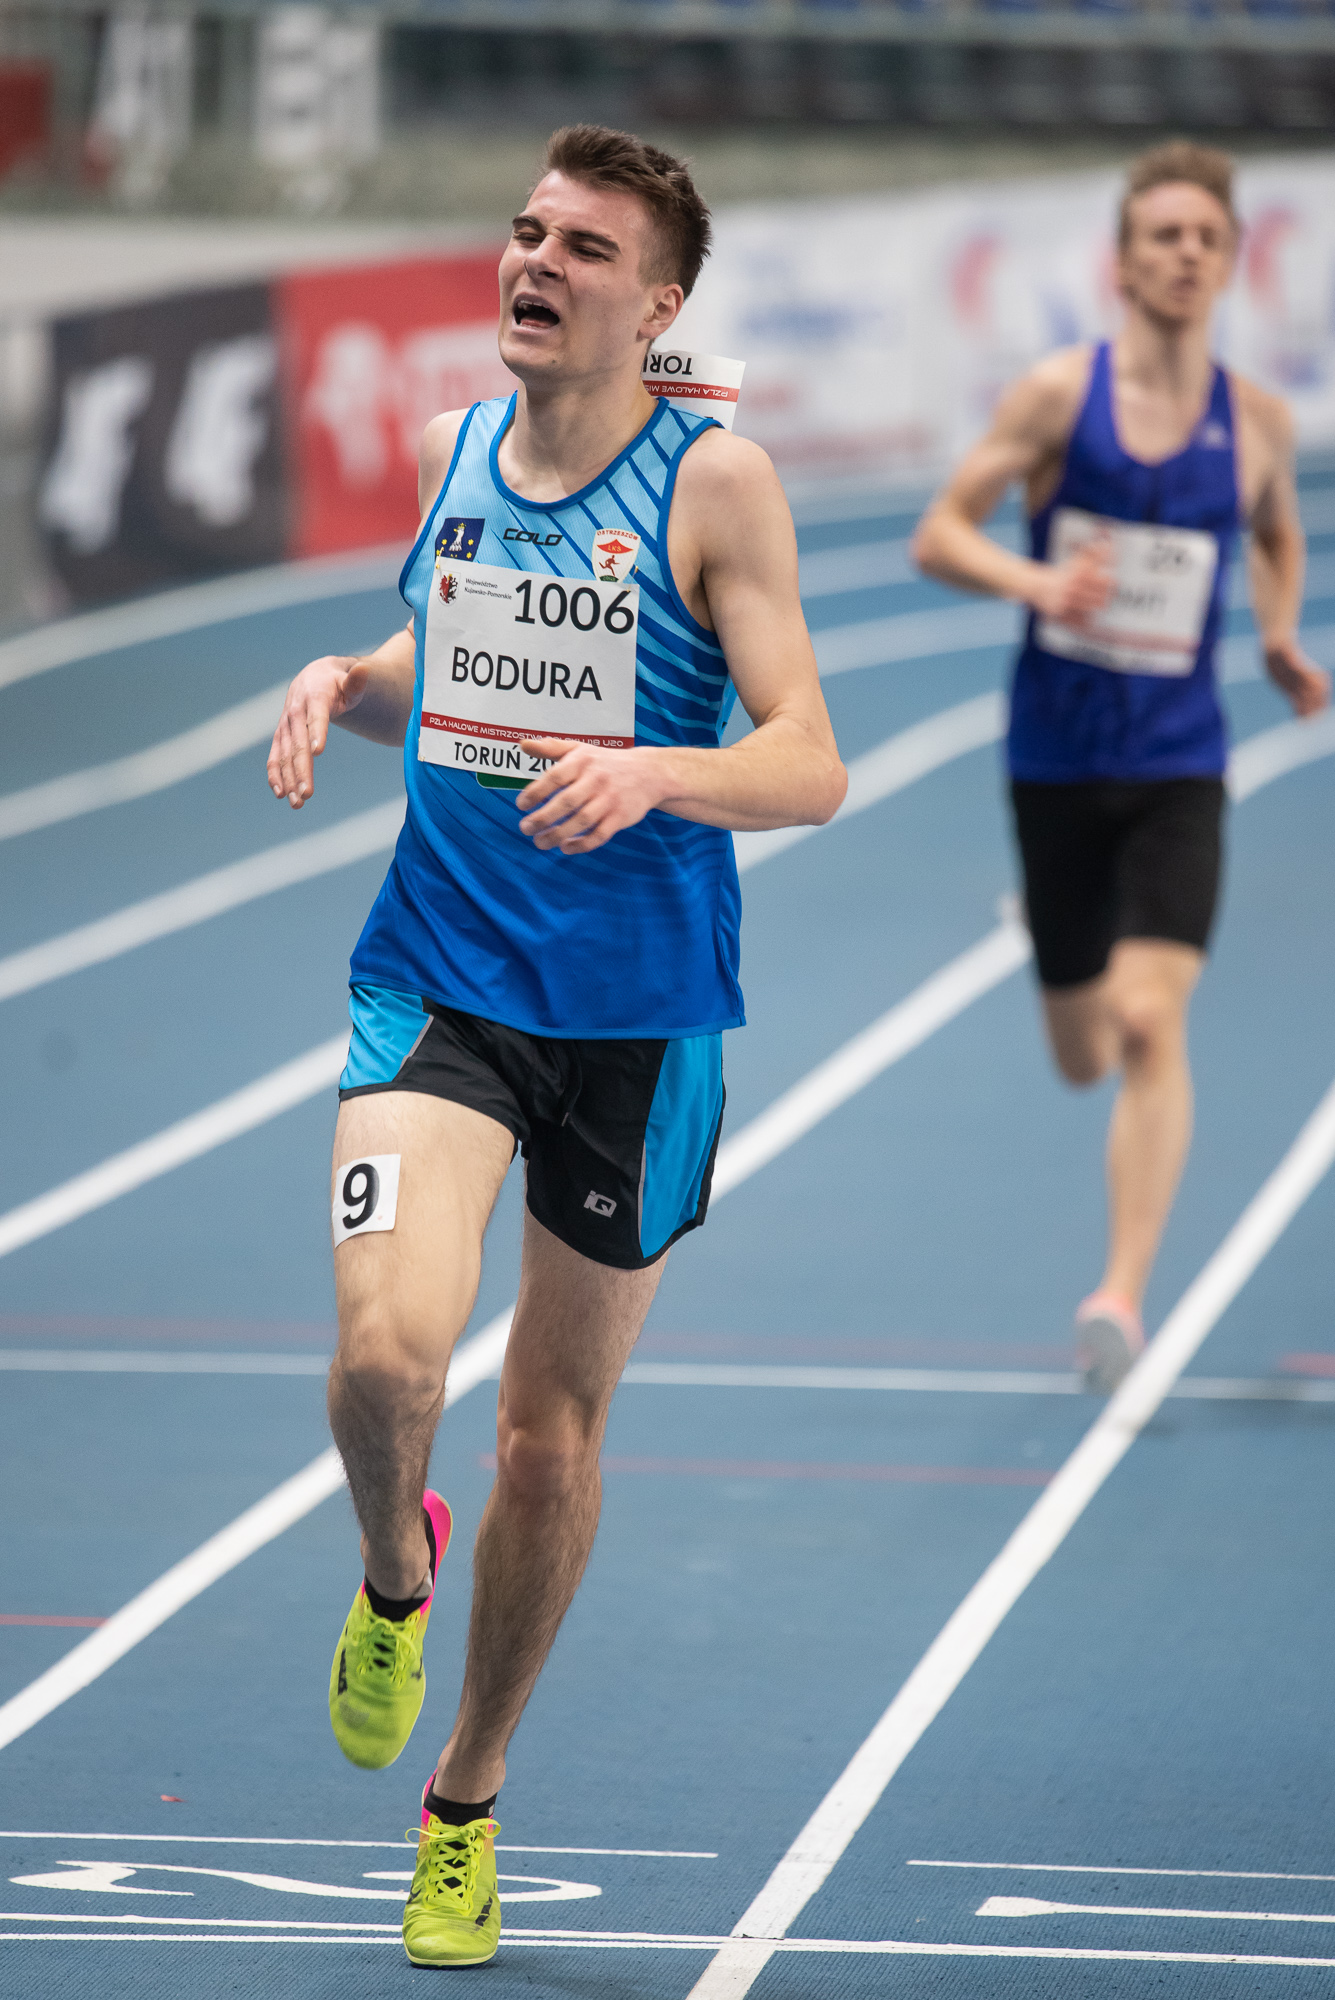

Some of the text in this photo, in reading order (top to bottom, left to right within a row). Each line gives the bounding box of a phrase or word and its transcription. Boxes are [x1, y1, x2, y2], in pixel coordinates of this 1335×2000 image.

[661, 385, 701, 394] HALOWE
[702, 388, 729, 398] PZLA
[503, 528, 563, 546] COLO
[514, 579, 634, 634] 1006
[451, 646, 602, 701] BODURA
[429, 717, 448, 727] PZLA
[448, 721, 478, 733] HALOWE
[602, 739, 624, 747] U20
[454, 741, 520, 770] TORUŃ
[342, 1163, 380, 1230] 9
